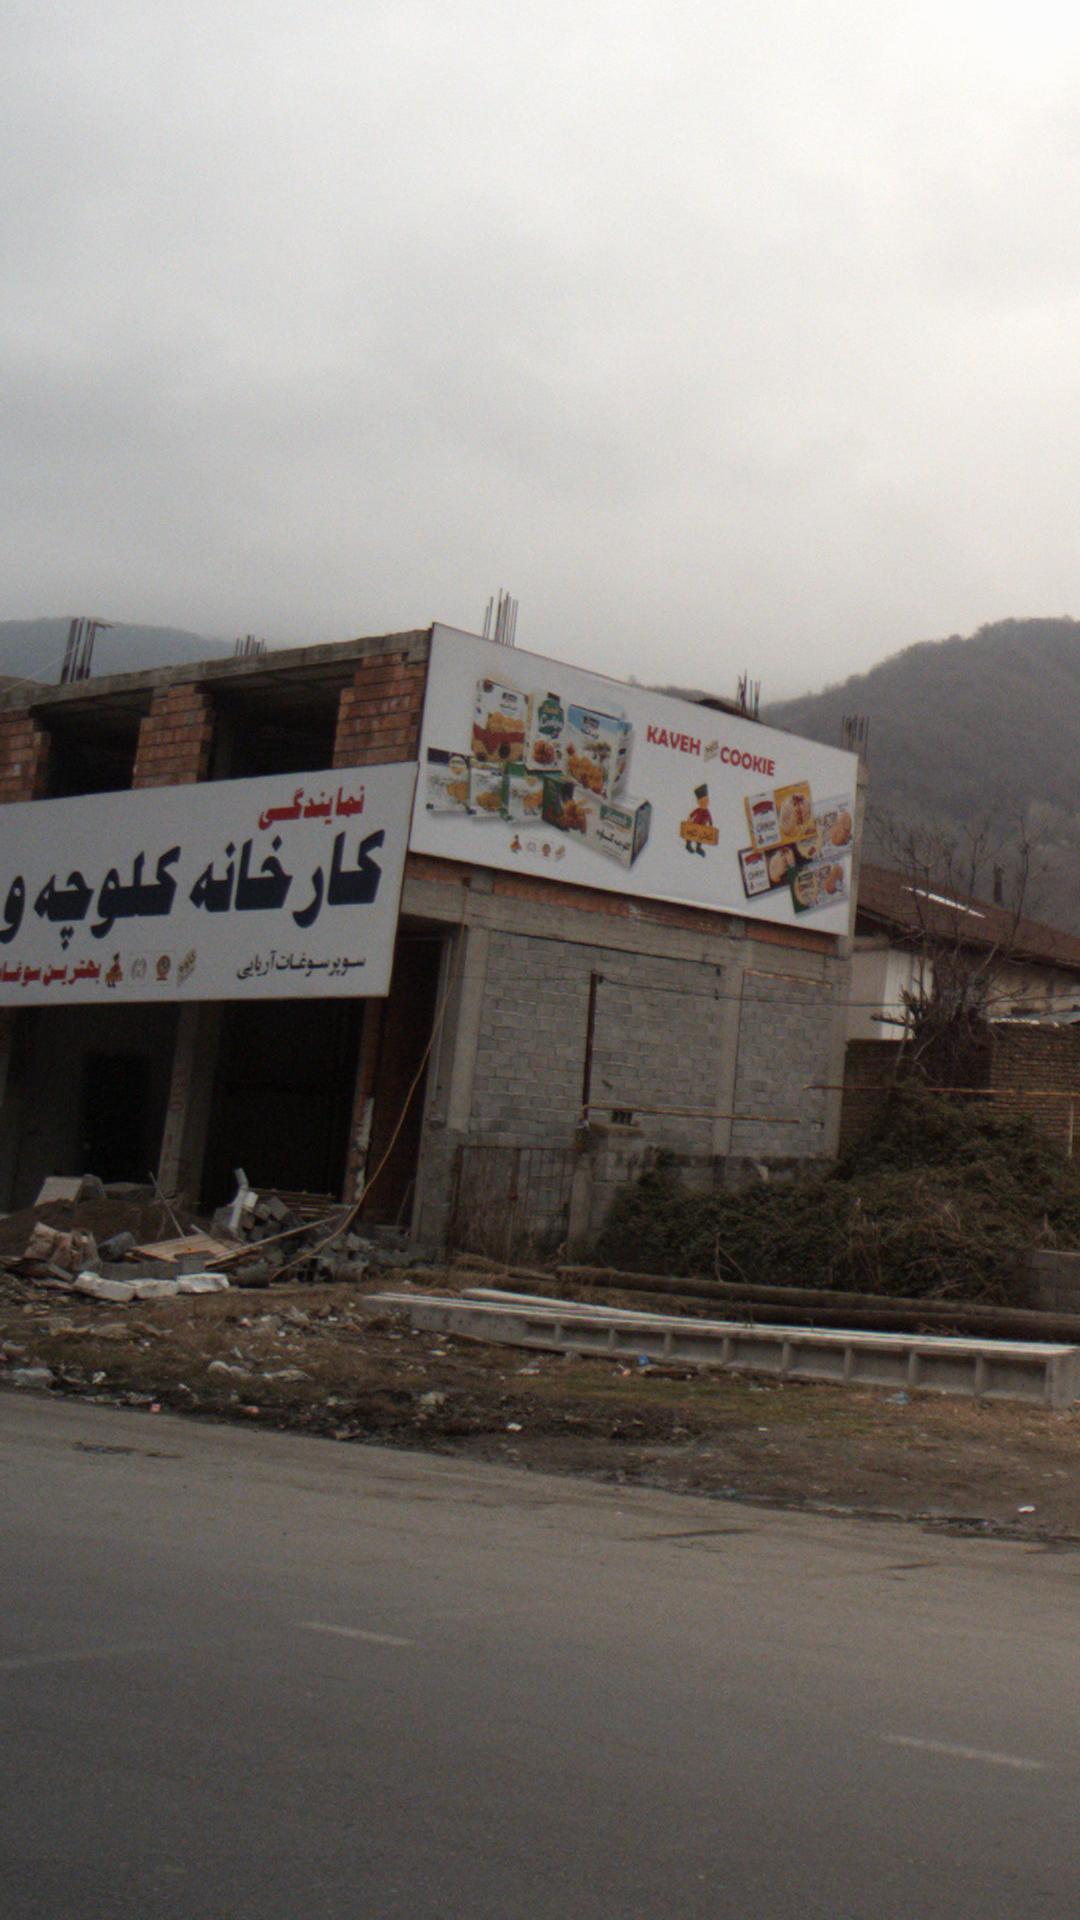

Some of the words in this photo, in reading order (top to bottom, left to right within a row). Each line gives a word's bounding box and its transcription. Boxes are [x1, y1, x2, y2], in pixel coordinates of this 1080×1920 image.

[646, 725, 702, 756] KAVEH
[720, 746, 776, 776] COOKIE
[259, 786, 365, 830] نمایندگی
[33, 846, 181, 950] کلوچه
[190, 829, 385, 928] کارخانه
[43, 959, 101, 987] بهترین
[276, 952, 329, 977] سوغات
[328, 957, 367, 977] سوپر
